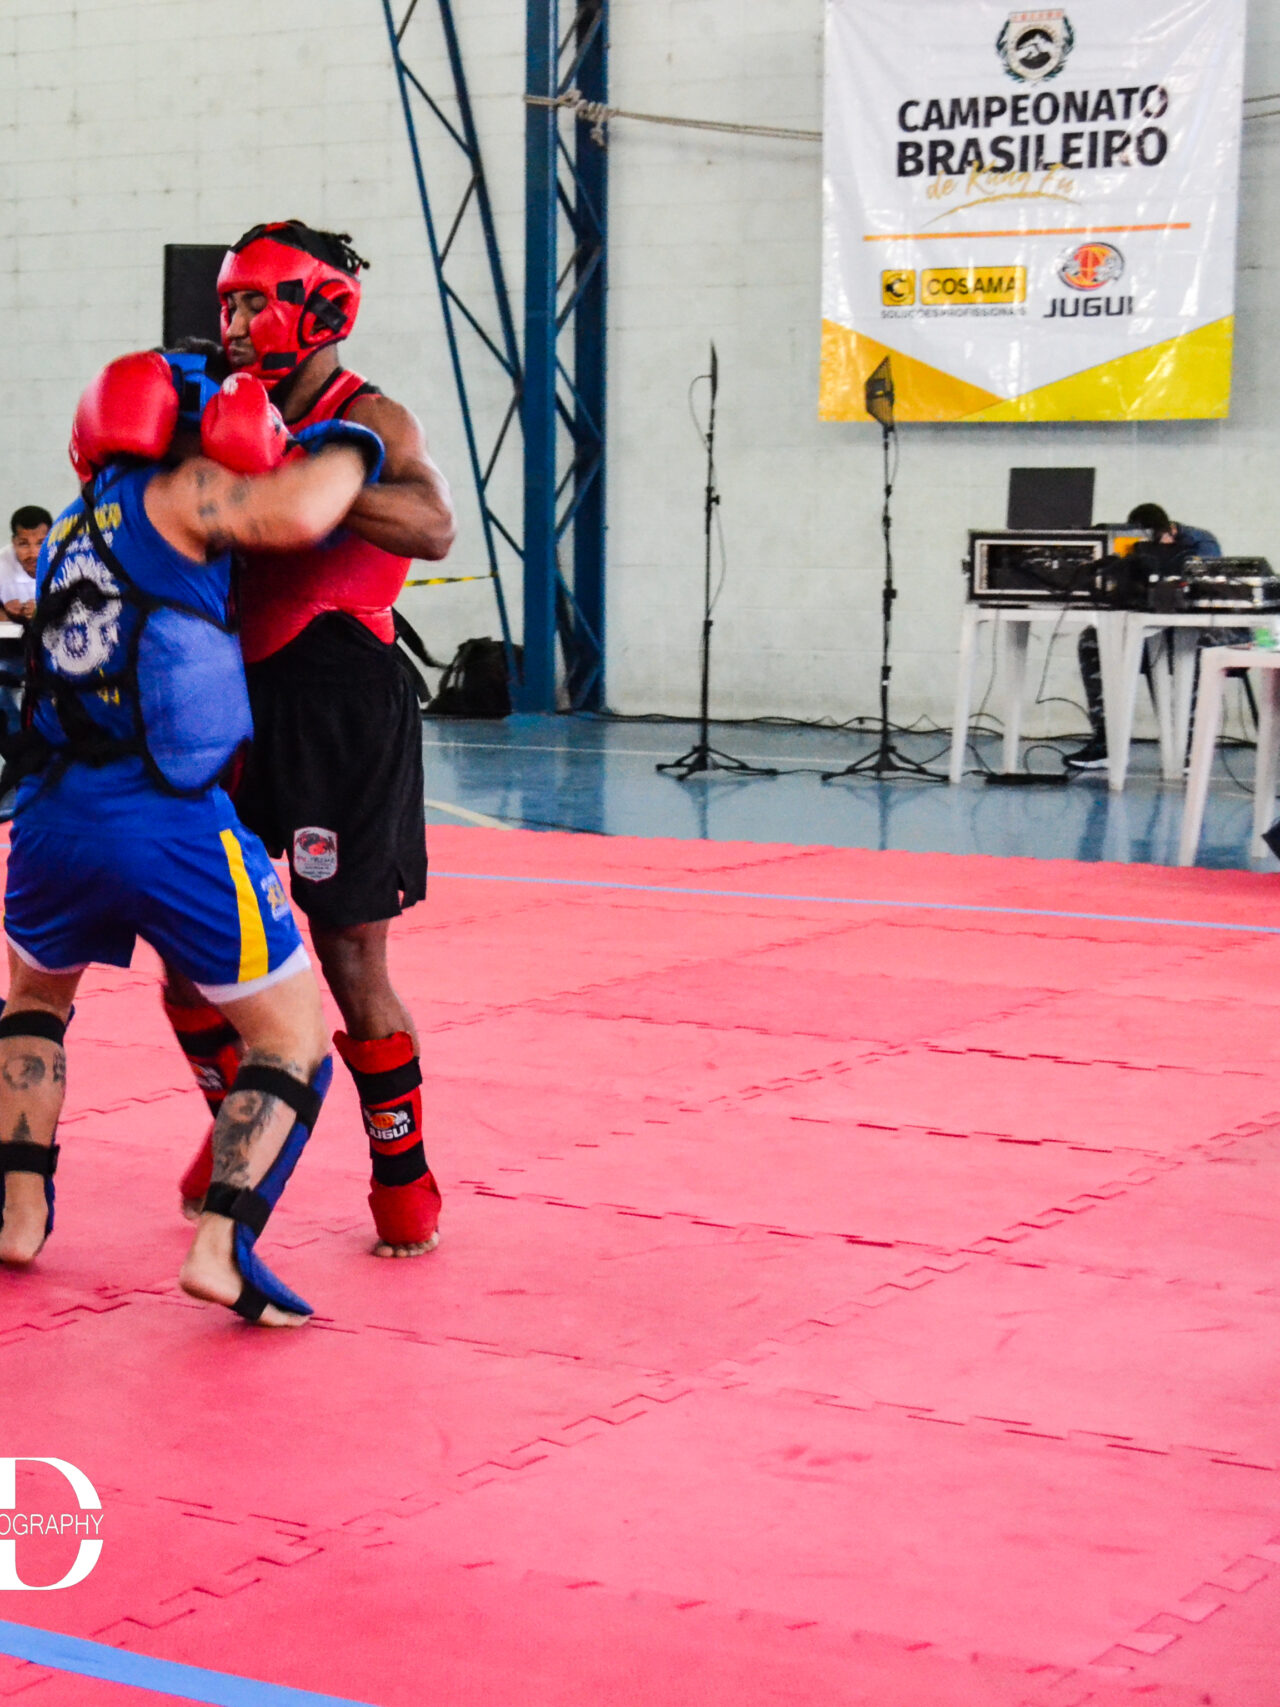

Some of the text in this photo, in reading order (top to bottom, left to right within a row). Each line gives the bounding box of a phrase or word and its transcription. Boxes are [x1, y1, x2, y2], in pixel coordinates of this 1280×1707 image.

[897, 84, 1169, 132] CAMPEONATO
[897, 126, 1168, 177] BRASILEIRO
[926, 168, 958, 200] de
[966, 159, 1033, 196] Kung
[926, 276, 1018, 296] COSAMA
[1042, 295, 1134, 318] JUGUI
